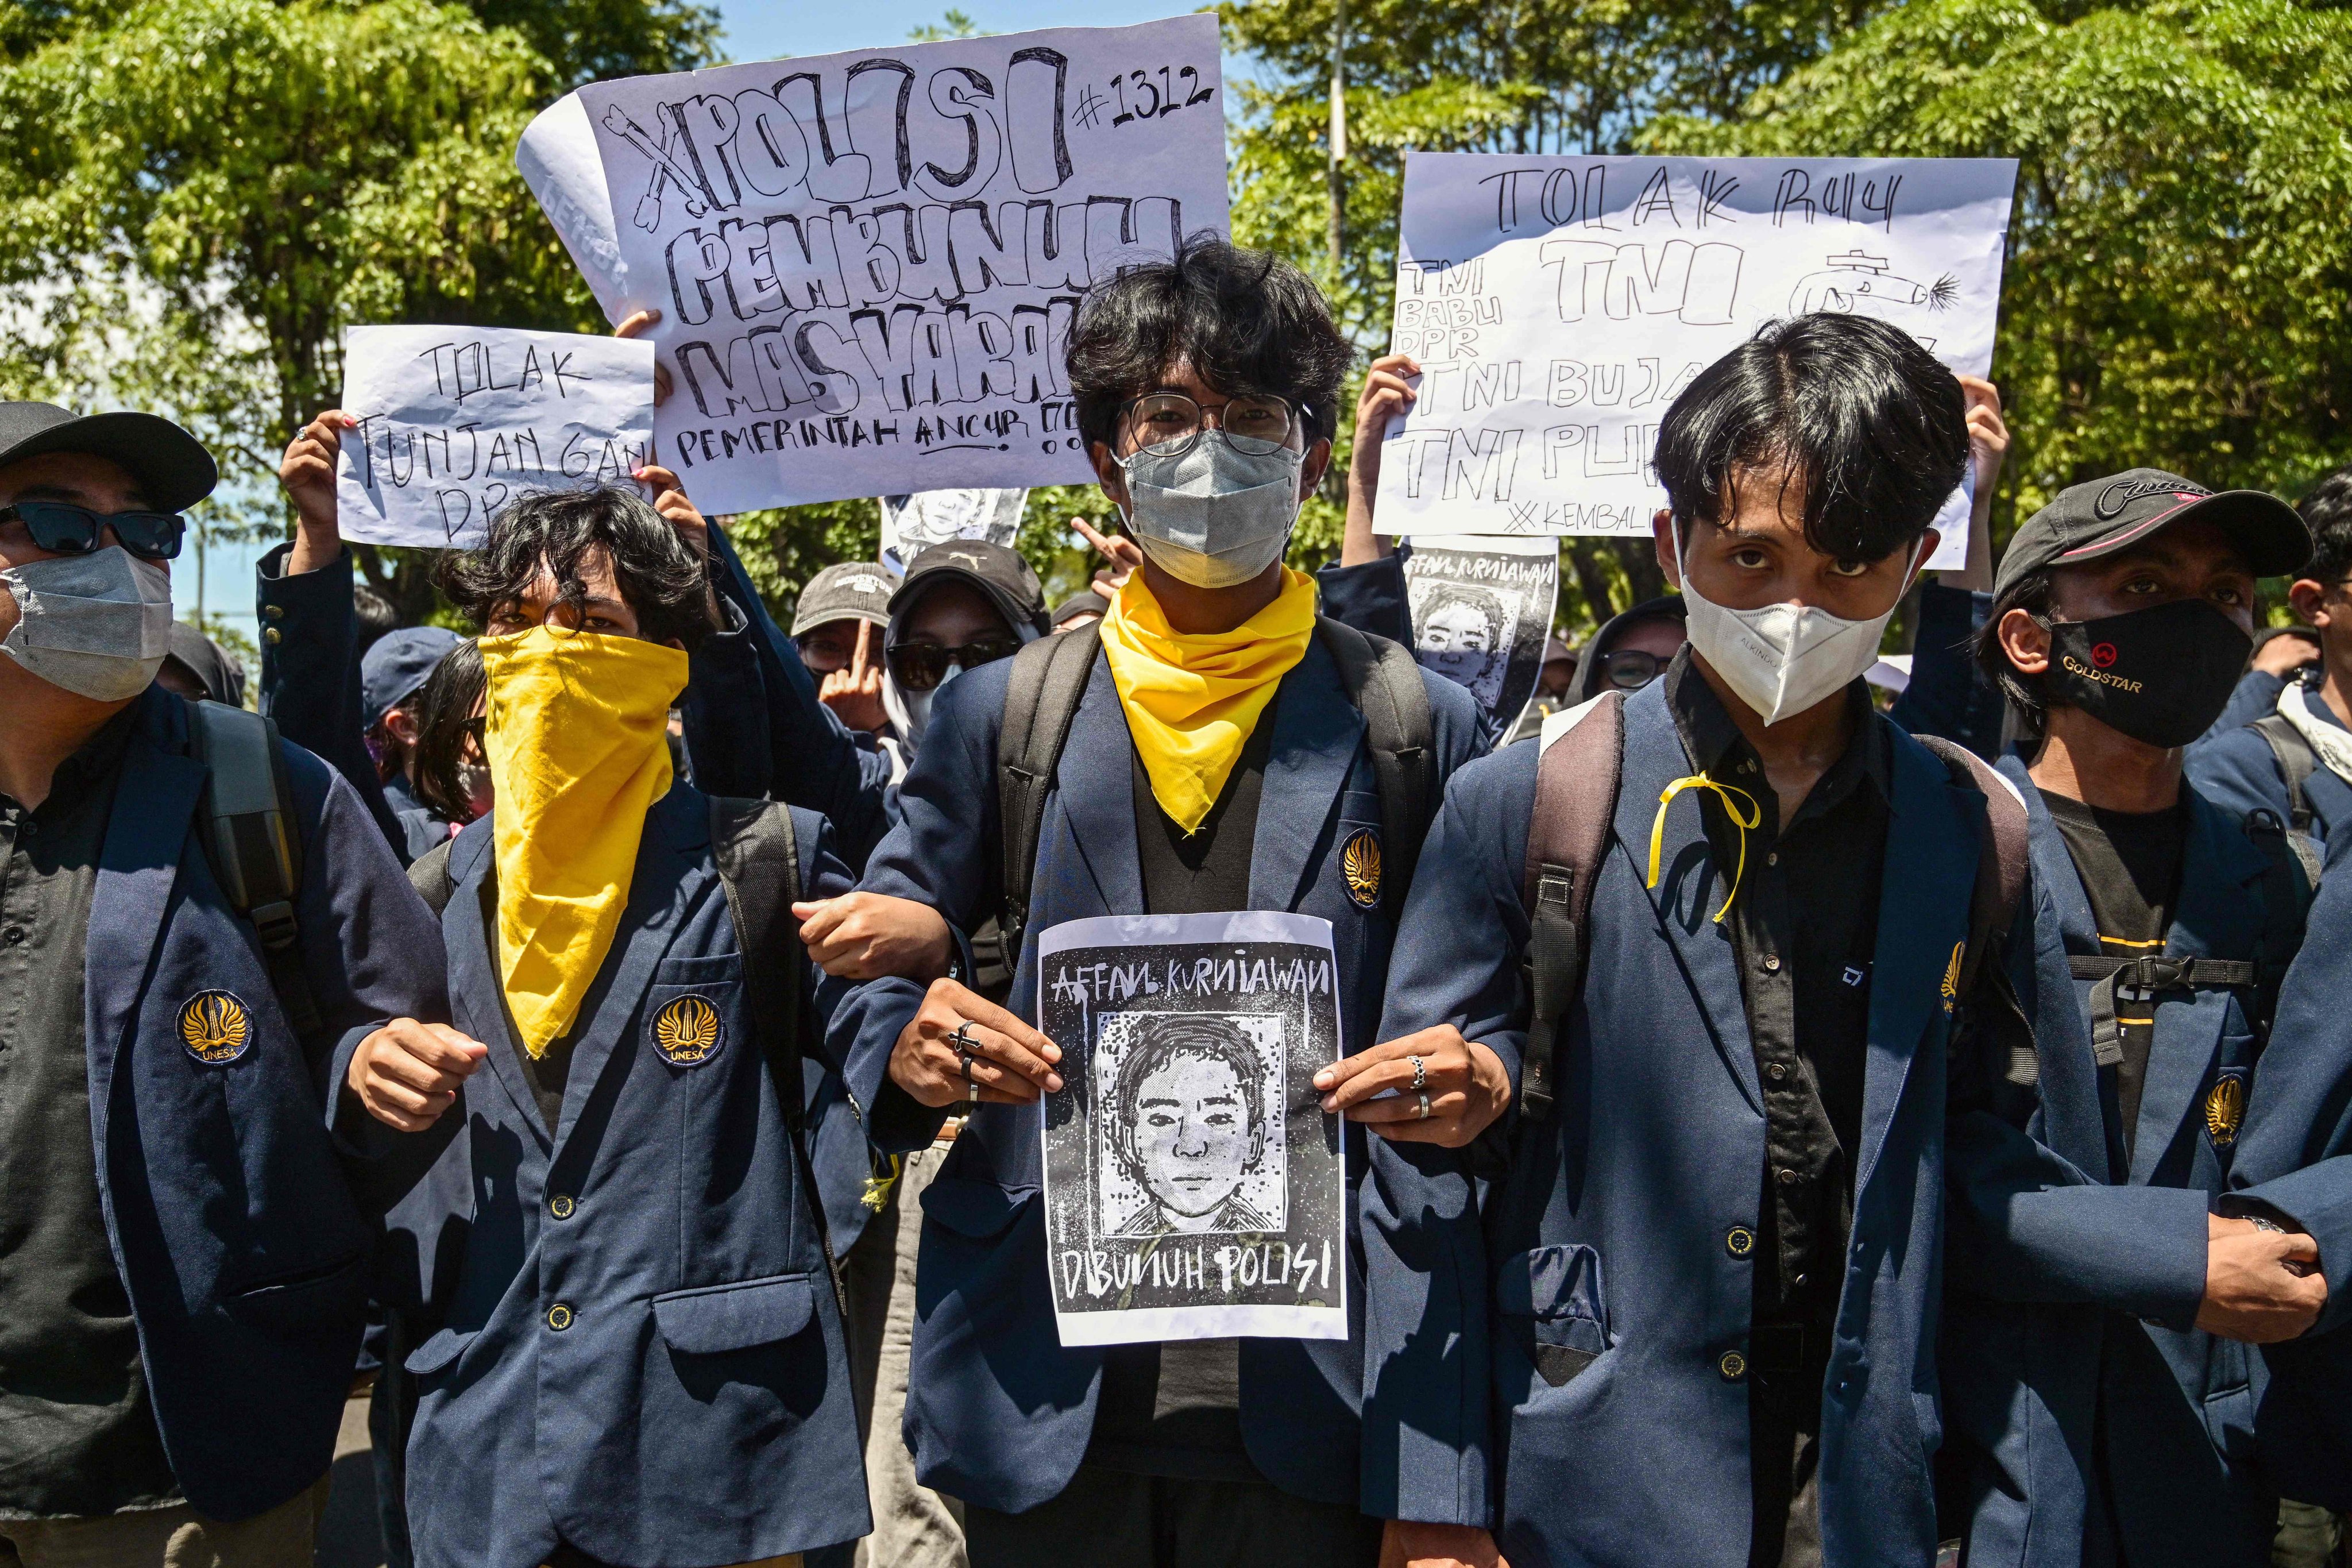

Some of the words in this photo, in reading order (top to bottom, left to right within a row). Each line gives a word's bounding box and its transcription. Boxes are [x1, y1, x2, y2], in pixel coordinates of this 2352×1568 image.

[1072, 65, 1215, 130] #1312
[1479, 165, 1739, 232] TOLAK
[665, 195, 1182, 326] PEMBUNUH
[1400, 258, 1484, 296] TNI
[1540, 240, 1744, 325] TNI
[1397, 296, 1503, 328] BABU
[1395, 328, 1478, 359] DPR
[419, 341, 593, 405] TOLAK
[1399, 359, 1521, 416] TNI
[677, 416, 899, 468] PEMERINTAH
[1392, 428, 1523, 503] TNI
[437, 483, 536, 543] DP
[1741, 638, 1777, 667] ALKINDO
[2063, 655, 2142, 693] GOLDSTAR
[203, 1048, 238, 1061] UNESA
[671, 1049, 705, 1061] UNESA
[1214, 1240, 1330, 1292] POLISI
